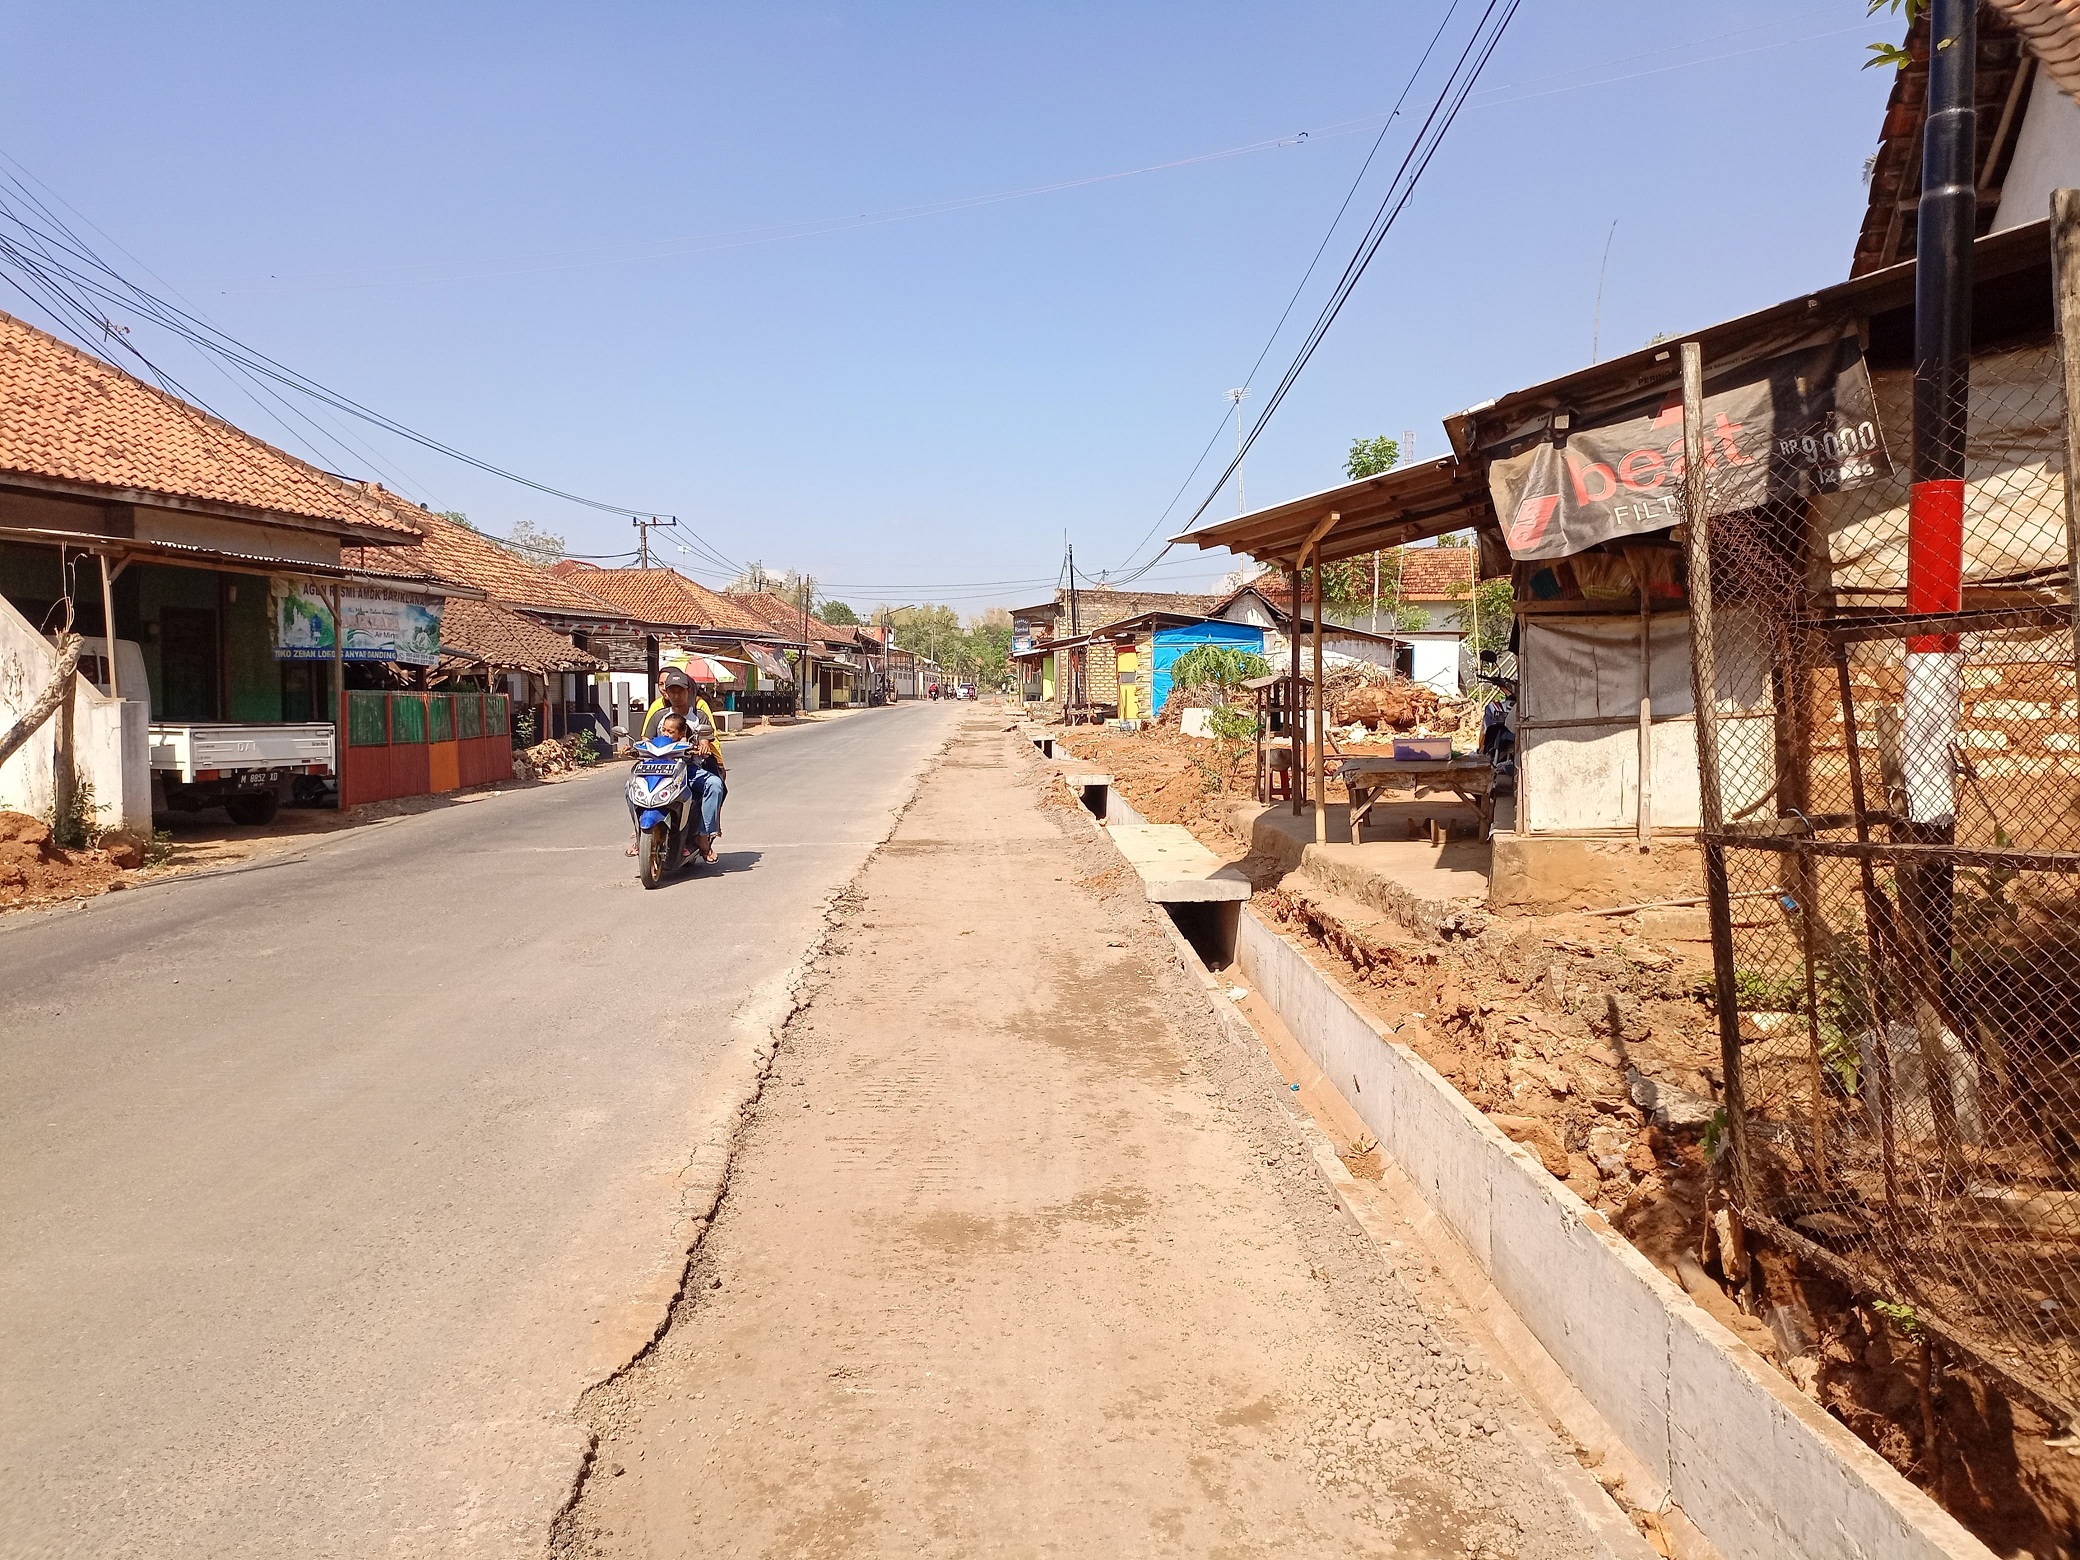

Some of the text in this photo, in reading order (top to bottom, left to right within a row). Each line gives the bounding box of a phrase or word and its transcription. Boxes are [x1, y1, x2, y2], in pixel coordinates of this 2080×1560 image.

[1801, 420, 1877, 465] 9.000
[329, 584, 356, 598] RSMI
[359, 587, 380, 600] AMDK
